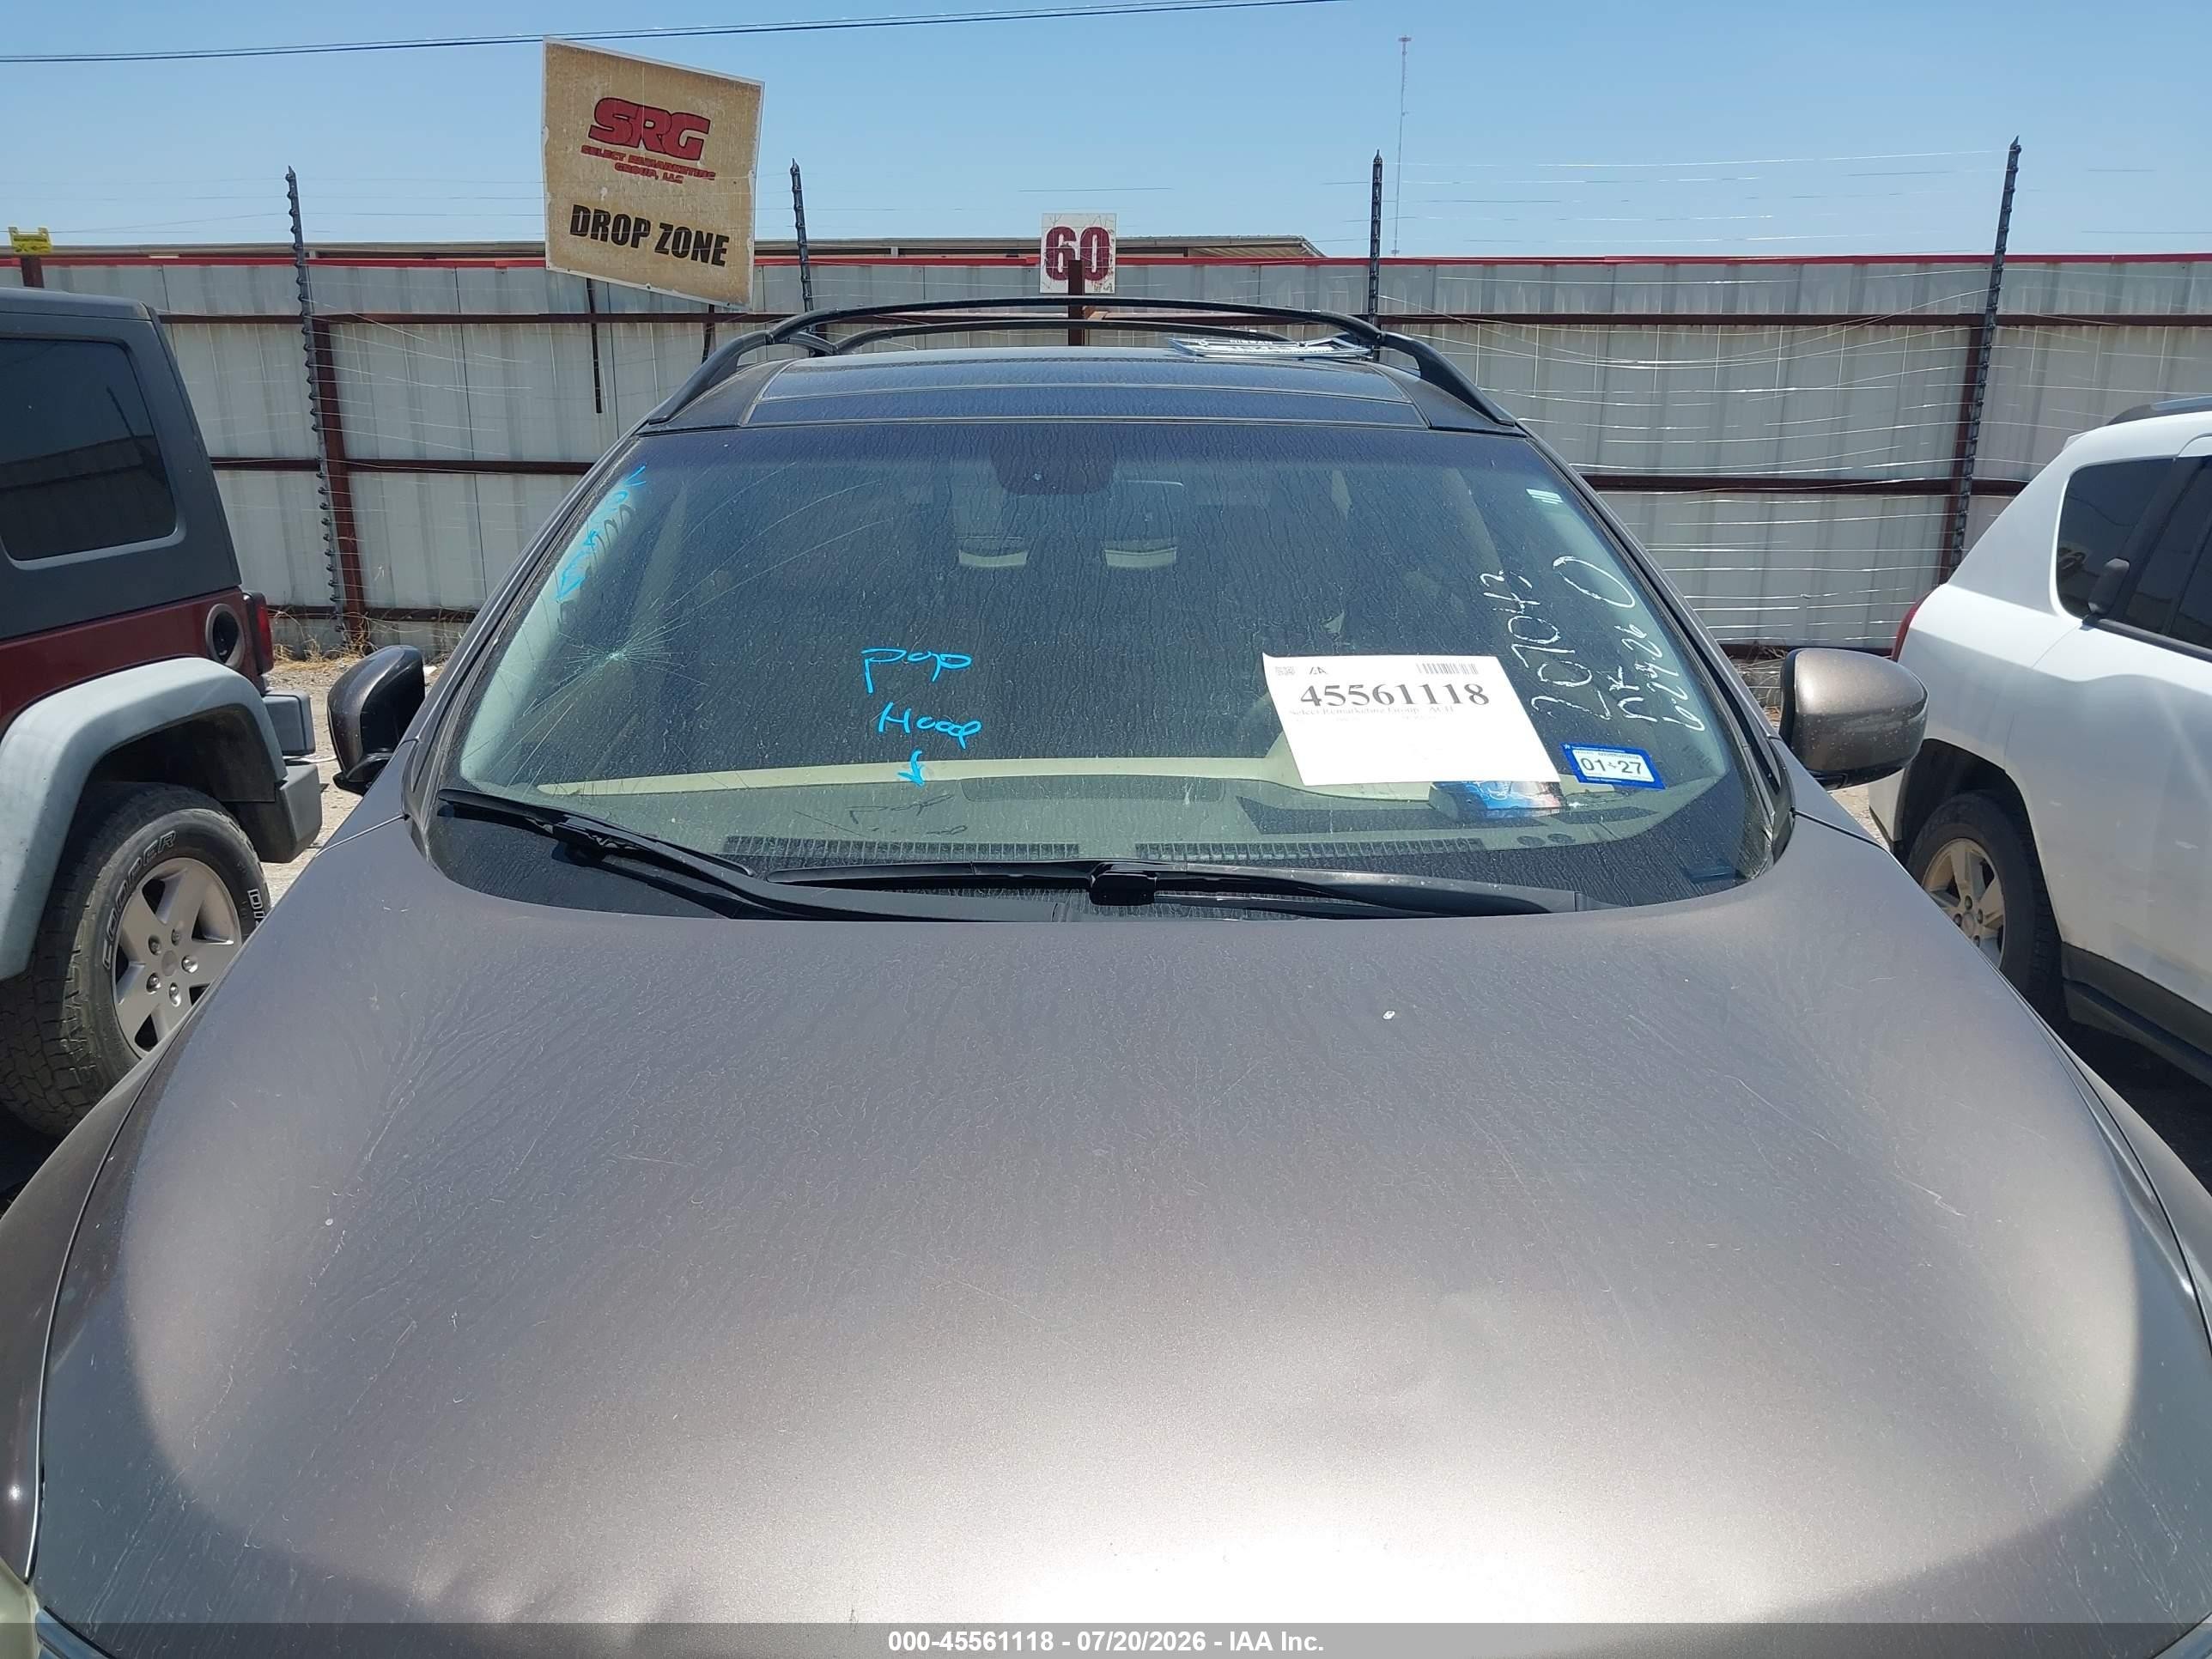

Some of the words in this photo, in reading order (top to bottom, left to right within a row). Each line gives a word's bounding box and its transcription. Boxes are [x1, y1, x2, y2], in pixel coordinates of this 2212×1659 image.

[580, 144, 627, 161] SELECT
[588, 96, 711, 161] SRG
[569, 204, 651, 249] DROP
[653, 222, 730, 267] ZONE
[1045, 226, 1111, 282] 60
[1299, 683, 1491, 708] 45561118
[102, 830, 177, 970] COOPER
